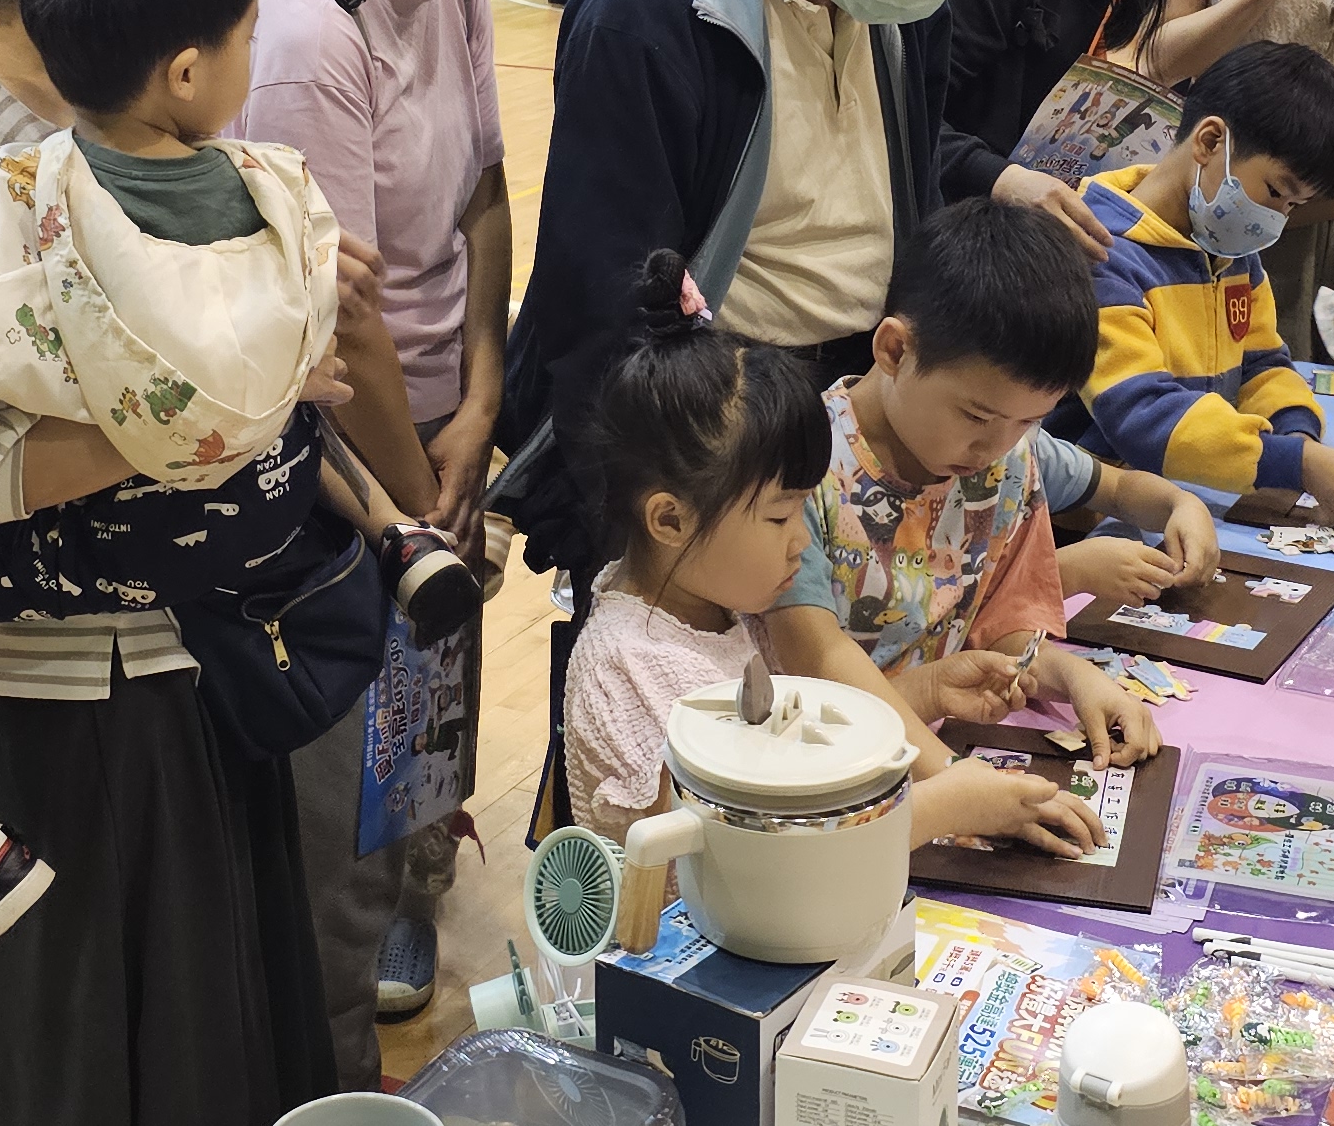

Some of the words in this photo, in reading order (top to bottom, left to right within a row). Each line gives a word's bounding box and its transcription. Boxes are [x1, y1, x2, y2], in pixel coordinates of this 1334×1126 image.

[1230, 297, 1247, 324] 89
[265, 486, 284, 501] CAN
[127, 580, 149, 588] YOU
